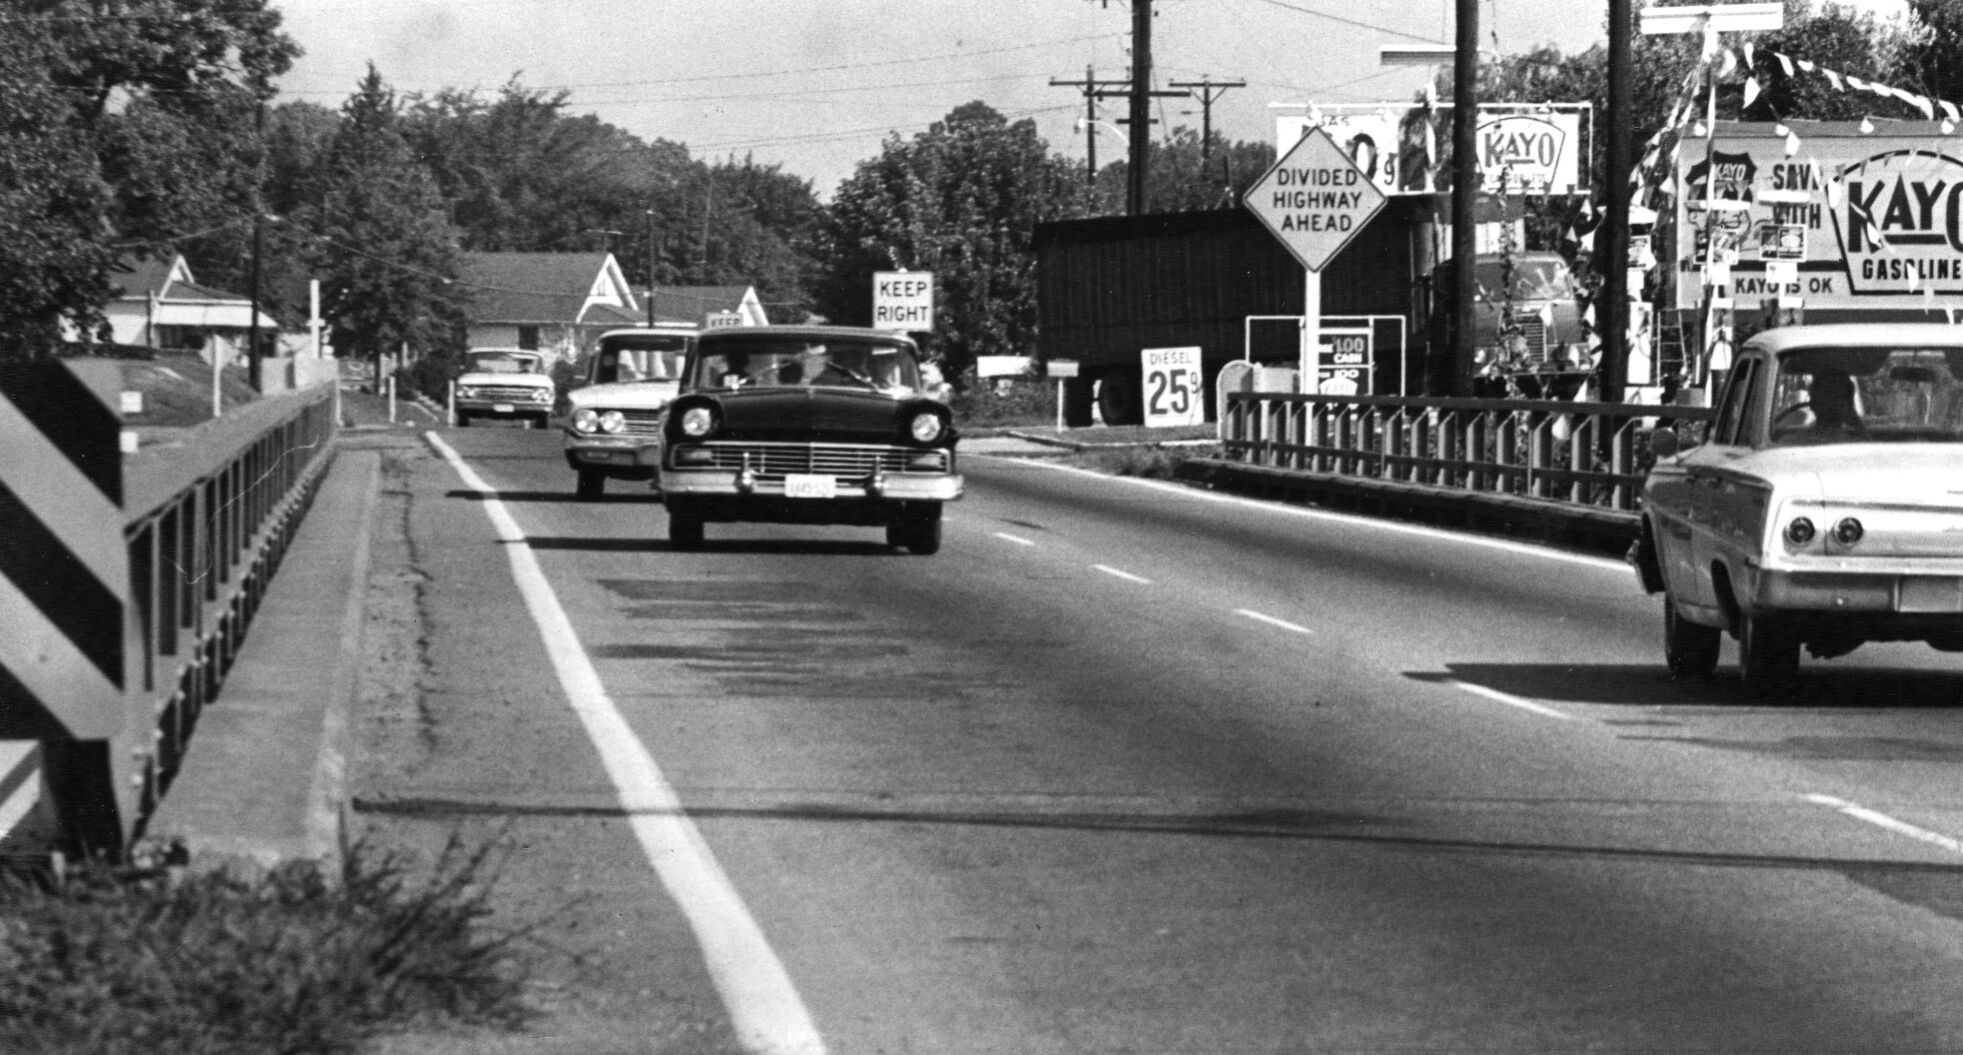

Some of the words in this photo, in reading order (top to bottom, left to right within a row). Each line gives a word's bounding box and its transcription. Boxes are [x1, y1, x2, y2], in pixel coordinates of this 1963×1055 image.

[1484, 132, 1555, 168] KAYO
[1278, 168, 1358, 186] DIVIDED
[1714, 163, 1747, 182] KAYO
[1273, 191, 1362, 209] HIGHWAY
[1773, 202, 1821, 229] WITH
[1848, 171, 1963, 254] KAYO
[1281, 214, 1352, 232] AHEAD
[880, 281, 927, 297] KEEP
[1735, 278, 1780, 294] KAYO
[1809, 278, 1833, 294] OK
[877, 306, 928, 322] RIGHT
[1150, 352, 1193, 365] DIESEL
